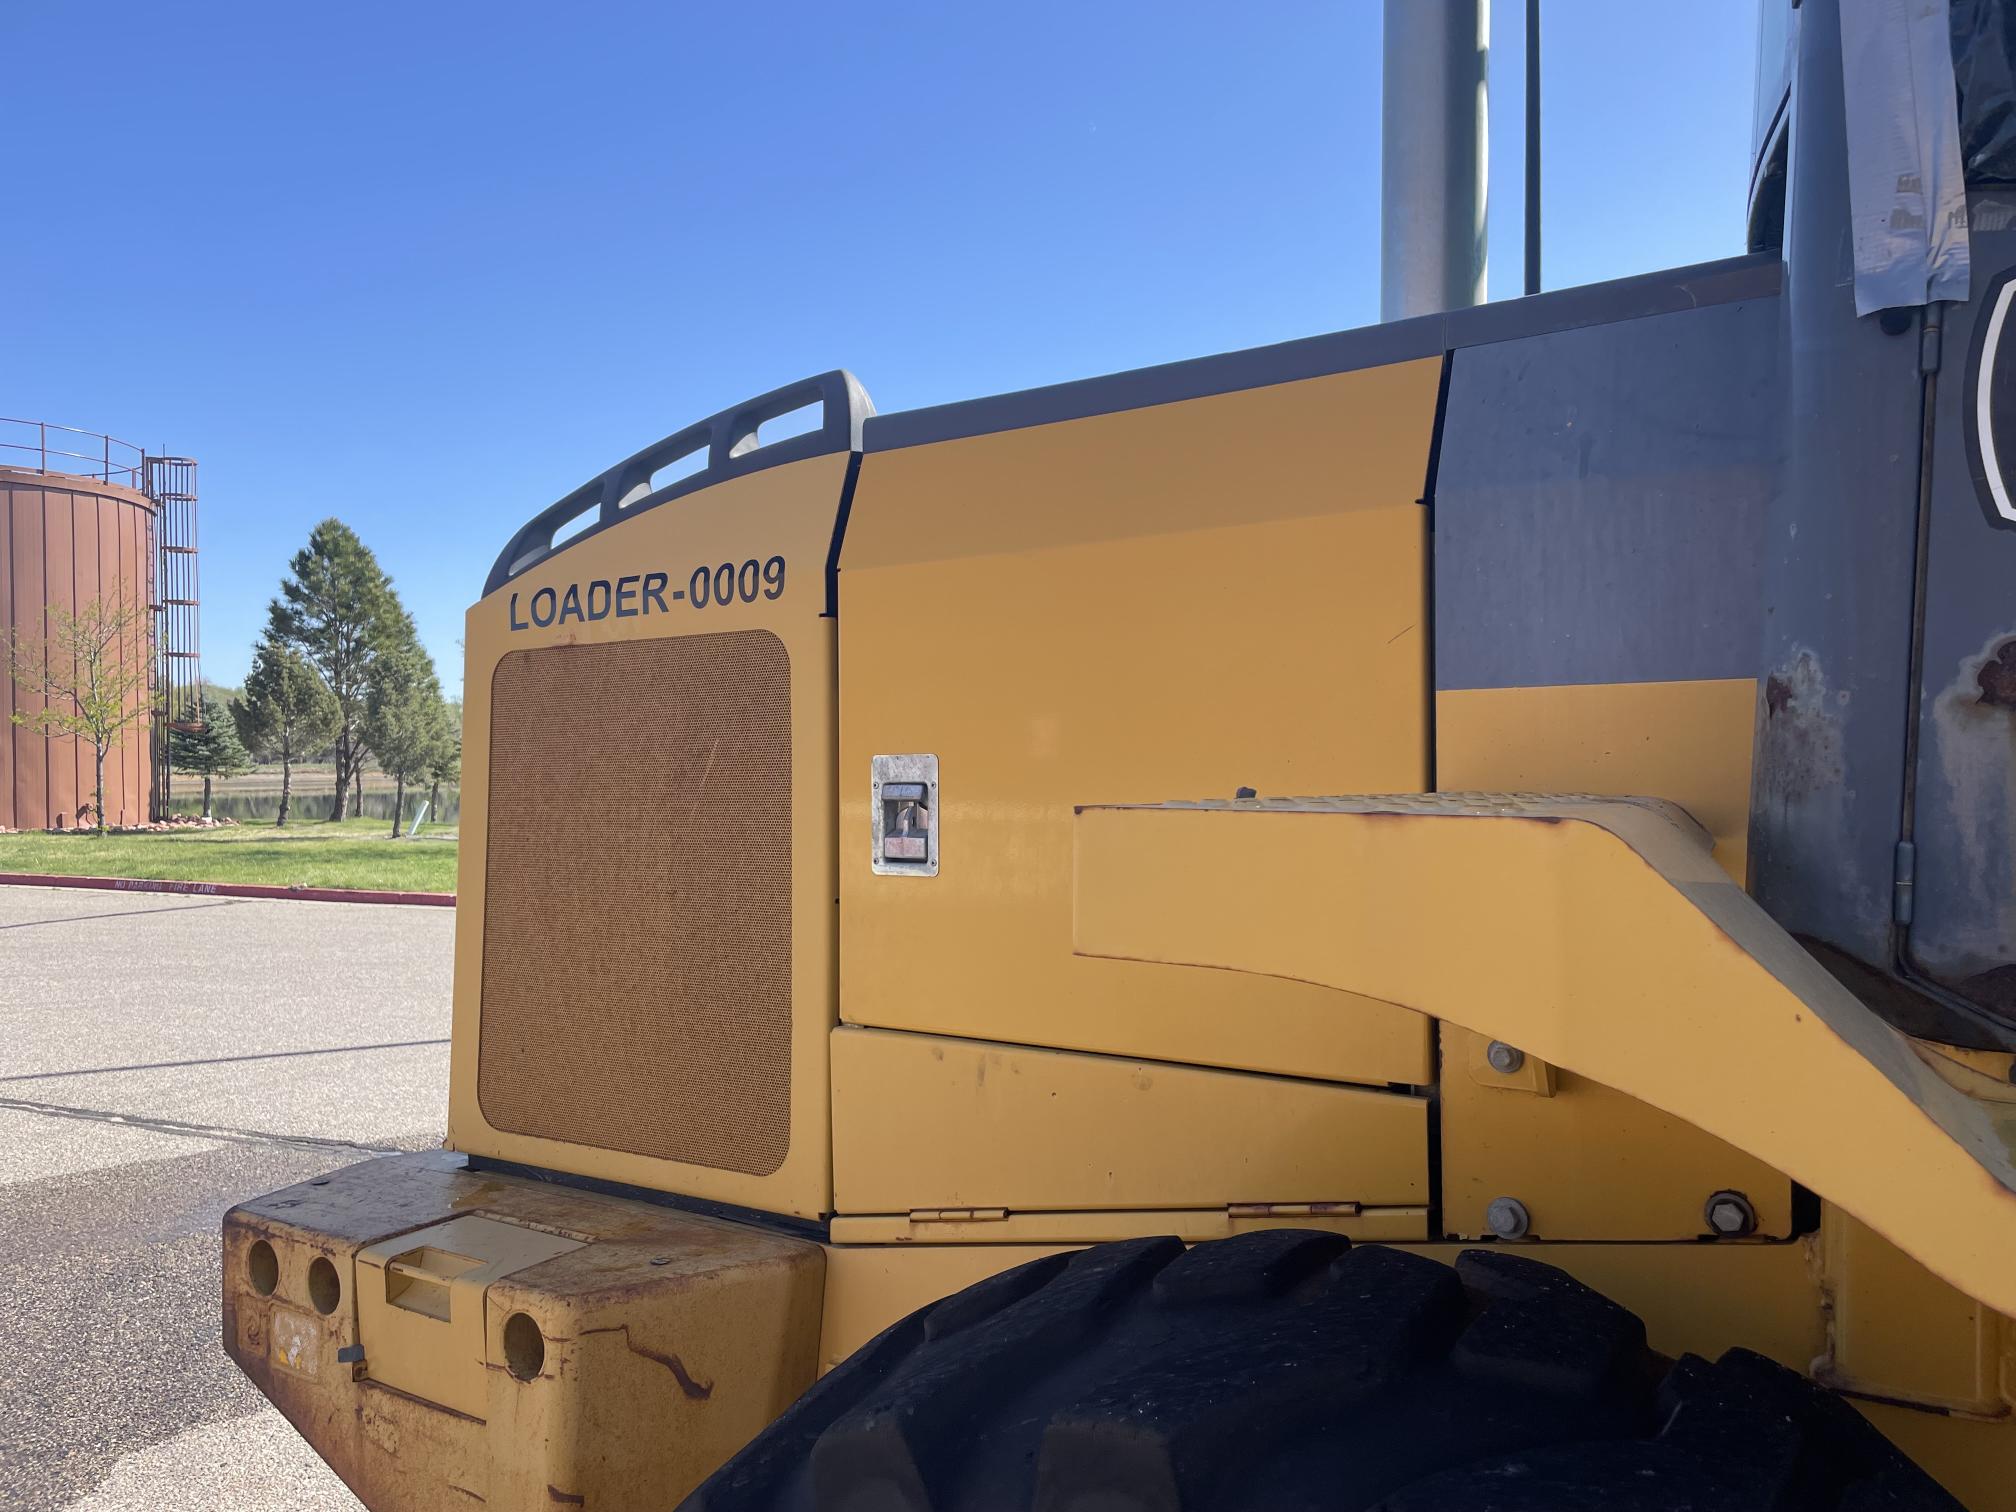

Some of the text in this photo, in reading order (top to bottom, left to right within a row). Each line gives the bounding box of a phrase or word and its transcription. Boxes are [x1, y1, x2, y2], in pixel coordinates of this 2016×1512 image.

[510, 555, 786, 631] LOADER-0009
[115, 880, 217, 893] NO PARKING FIRE LANE
